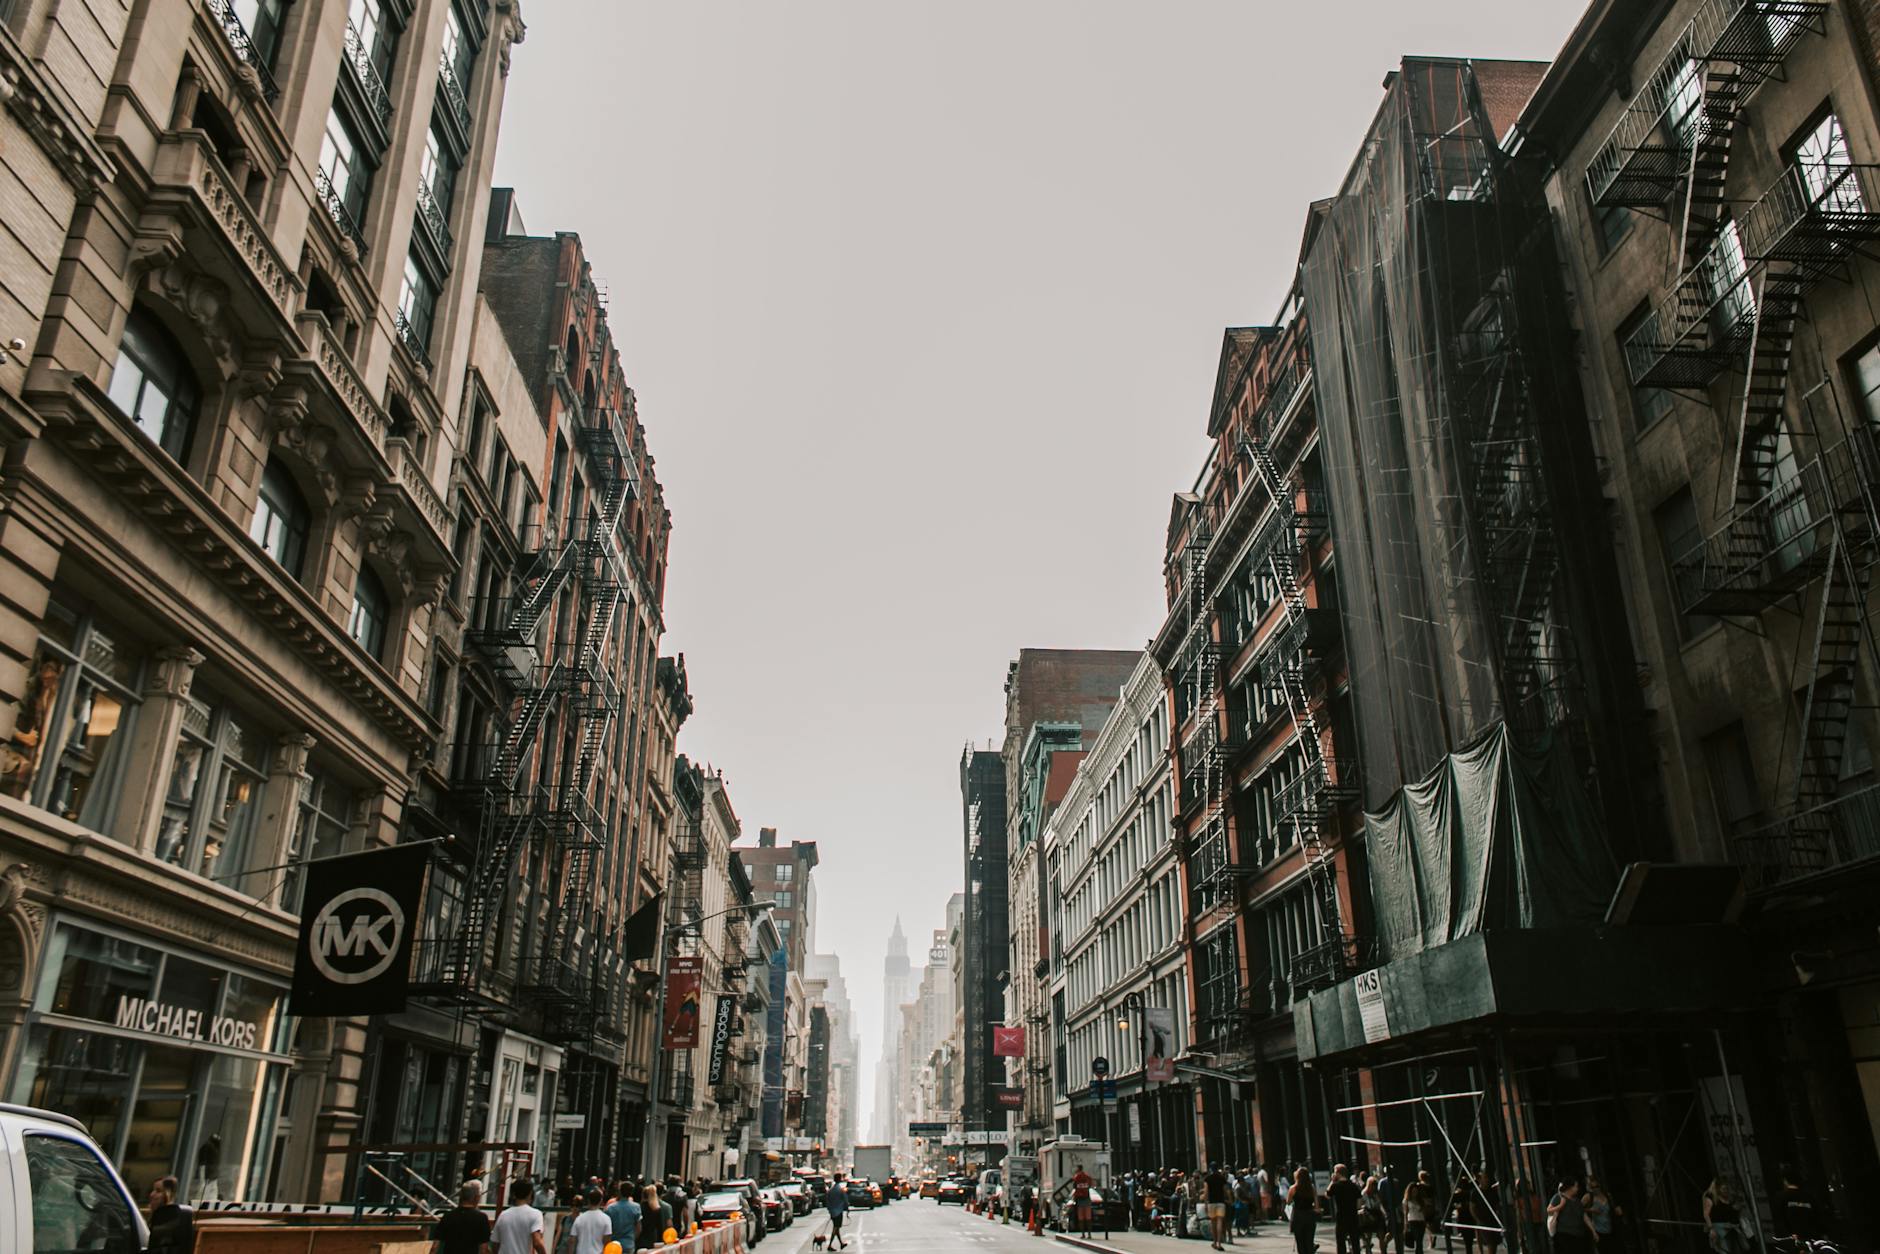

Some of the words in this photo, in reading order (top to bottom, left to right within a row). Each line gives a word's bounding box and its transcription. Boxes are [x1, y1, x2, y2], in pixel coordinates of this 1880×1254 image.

[321, 915, 392, 956] MK
[1357, 972, 1377, 995] HKS
[116, 995, 204, 1040] MICHAEL
[209, 1015, 256, 1050] KORS
